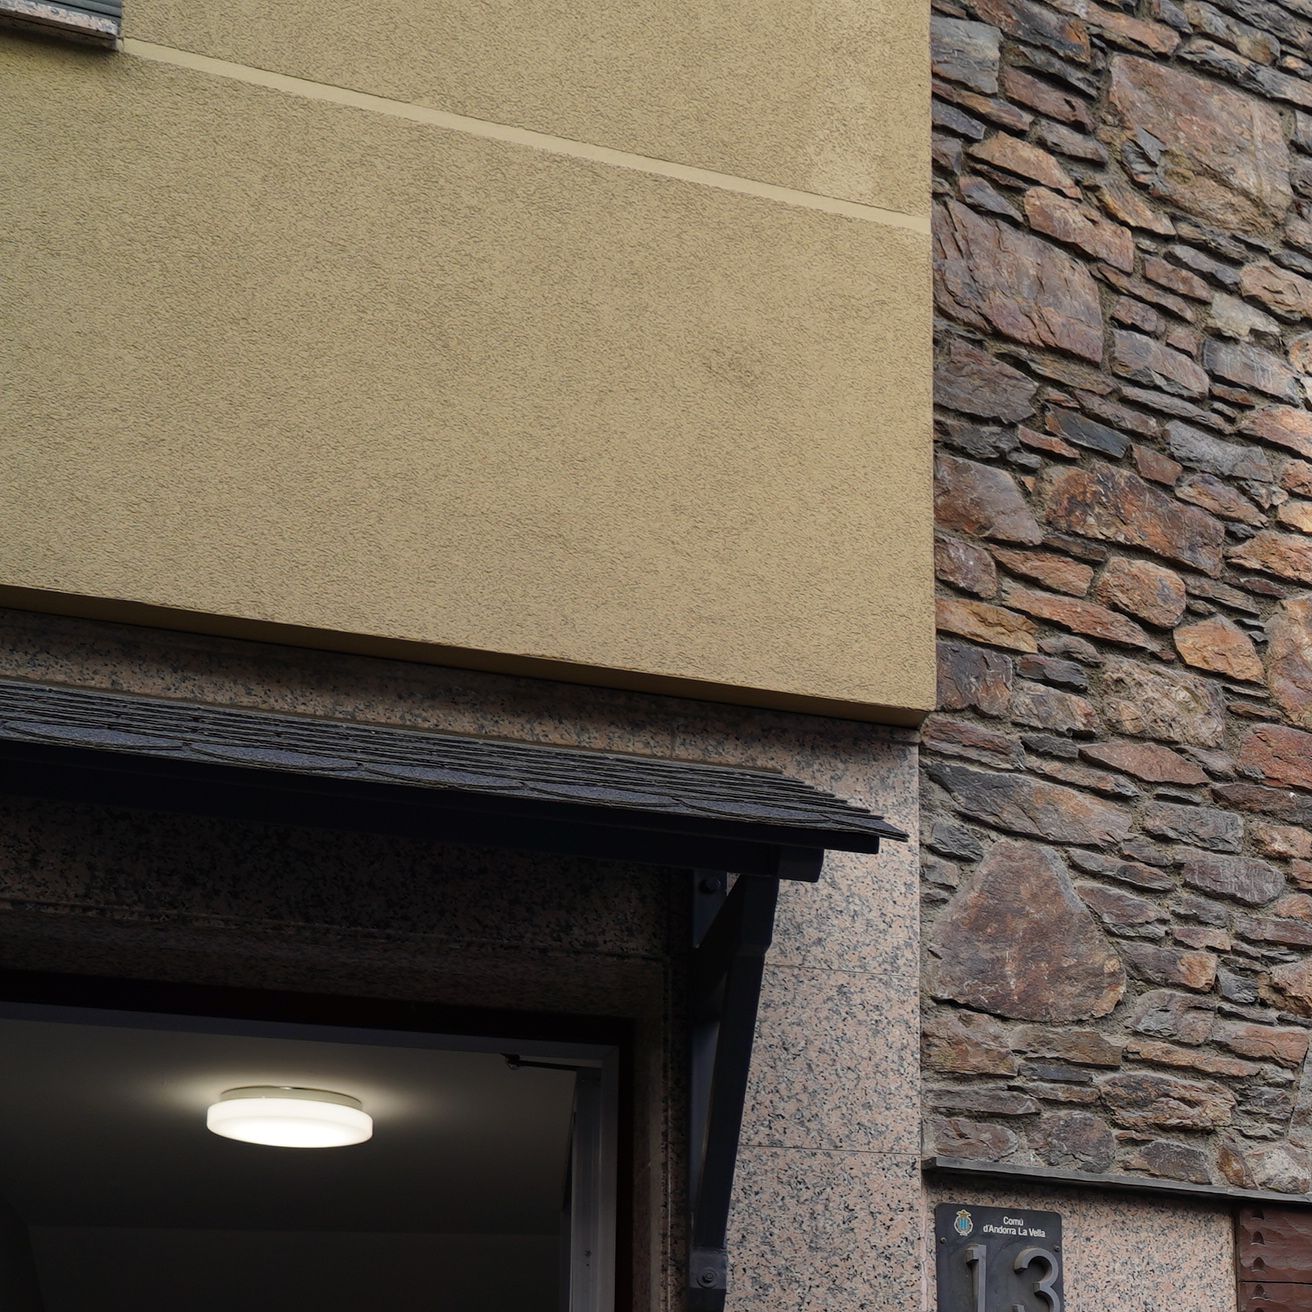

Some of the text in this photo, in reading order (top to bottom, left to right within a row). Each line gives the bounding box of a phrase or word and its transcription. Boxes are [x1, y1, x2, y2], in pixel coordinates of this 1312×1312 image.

[983, 1224, 1046, 1238] d'Andorra La Vella
